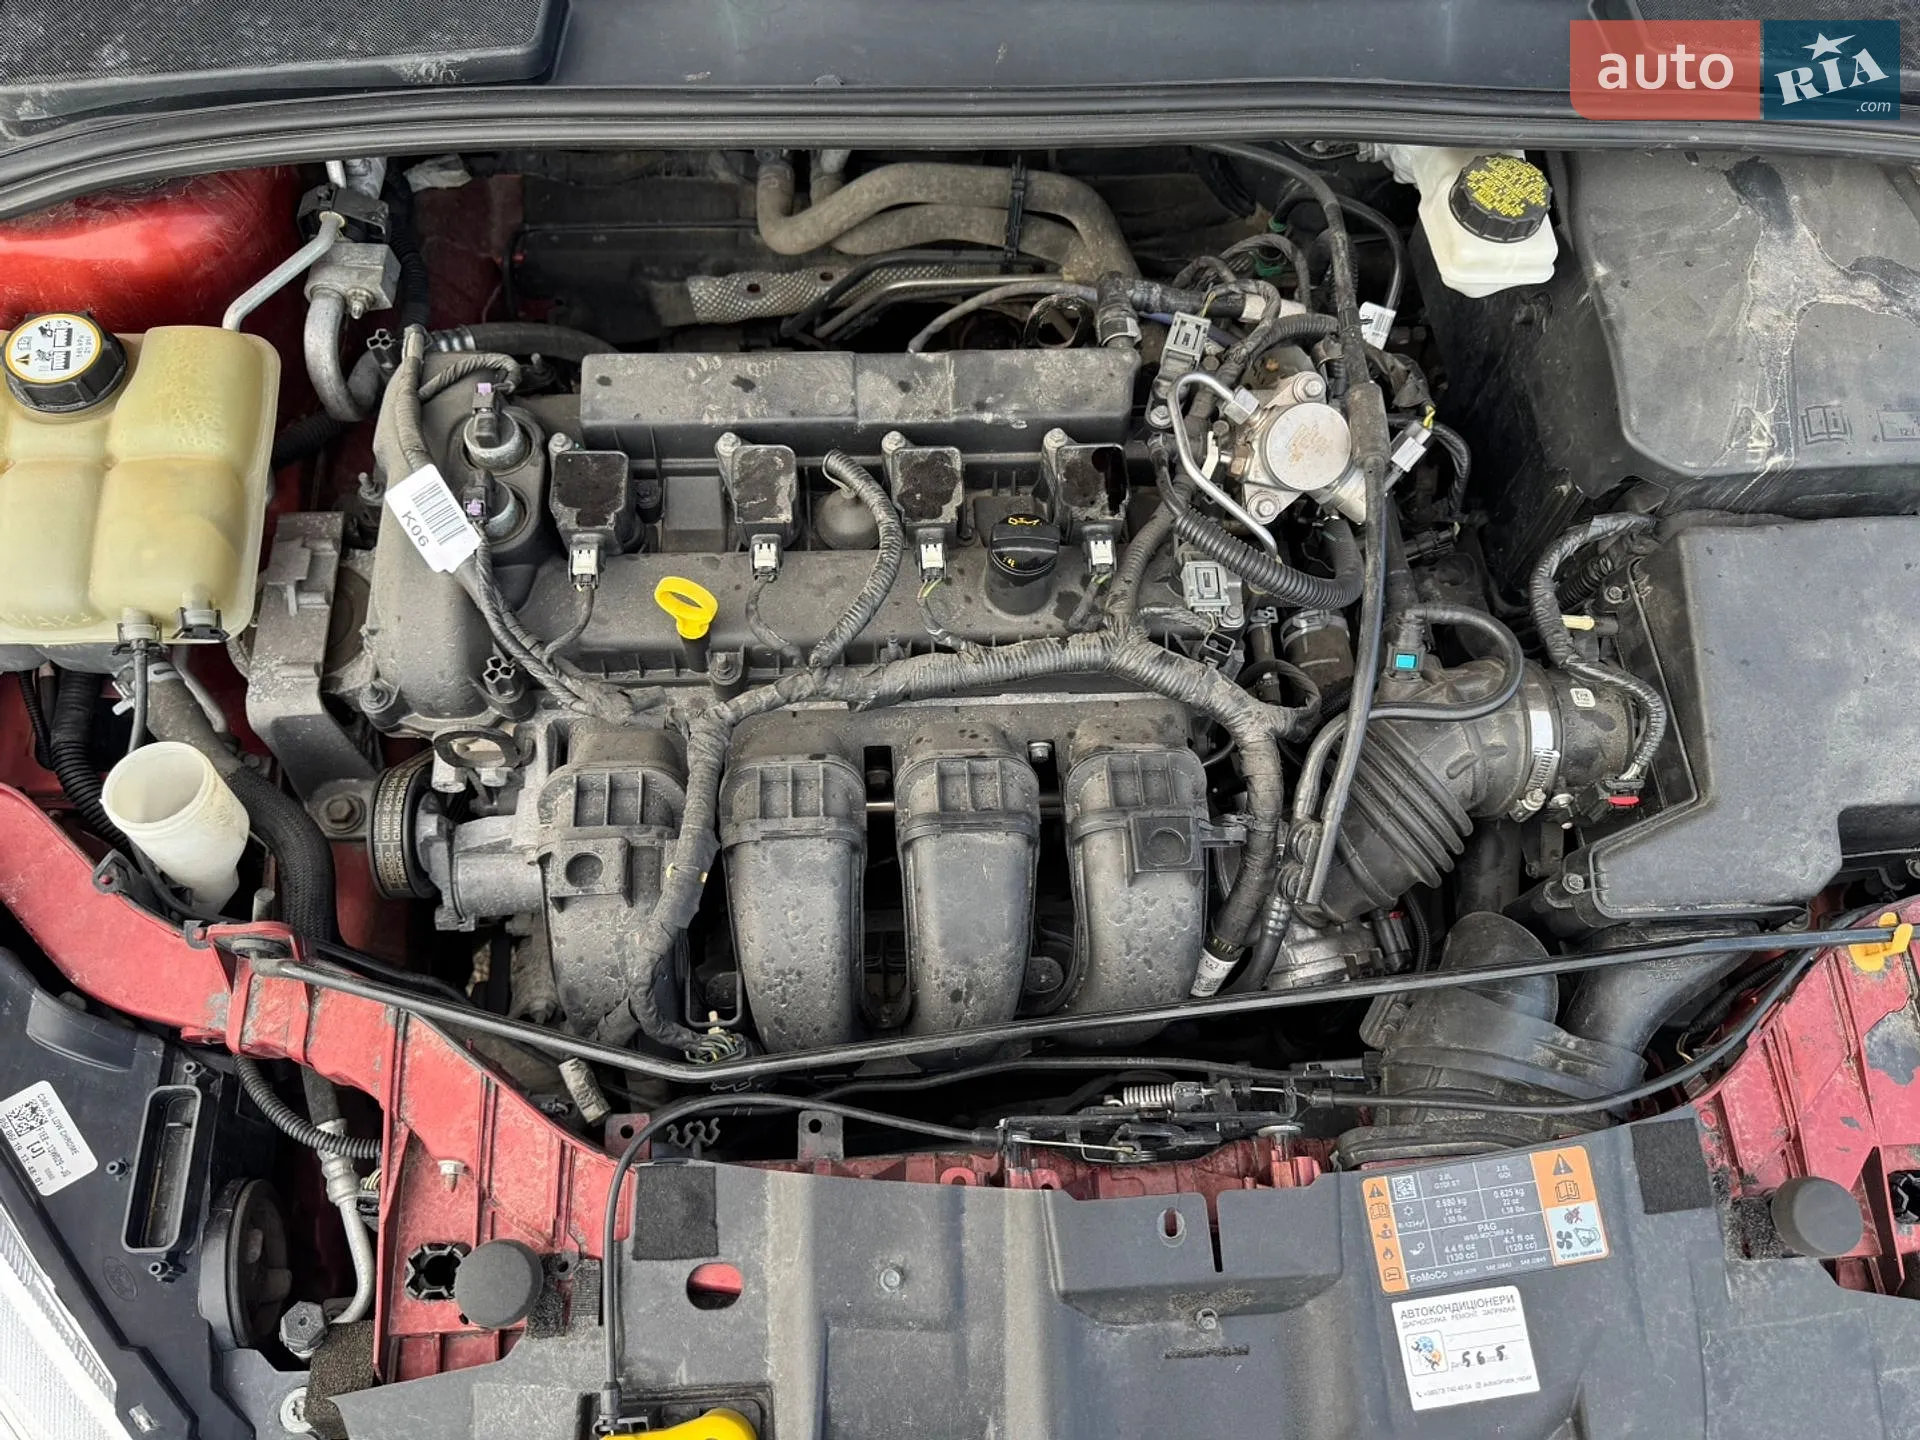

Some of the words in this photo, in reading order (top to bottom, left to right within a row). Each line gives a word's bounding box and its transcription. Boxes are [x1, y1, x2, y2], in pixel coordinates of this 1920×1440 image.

[401, 510, 429, 547] K06
[51, 1116, 64, 1130] LOW
[1514, 1187, 1525, 1198] kg
[1476, 1222, 1498, 1232] PAG
[1505, 1242, 1524, 1254] (120
[1524, 1240, 1537, 1251] cc)
[1409, 1270, 1449, 1283] FoMoCo
[1400, 1294, 1516, 1320] АВТОКОНДИЦІОНЕРИ
